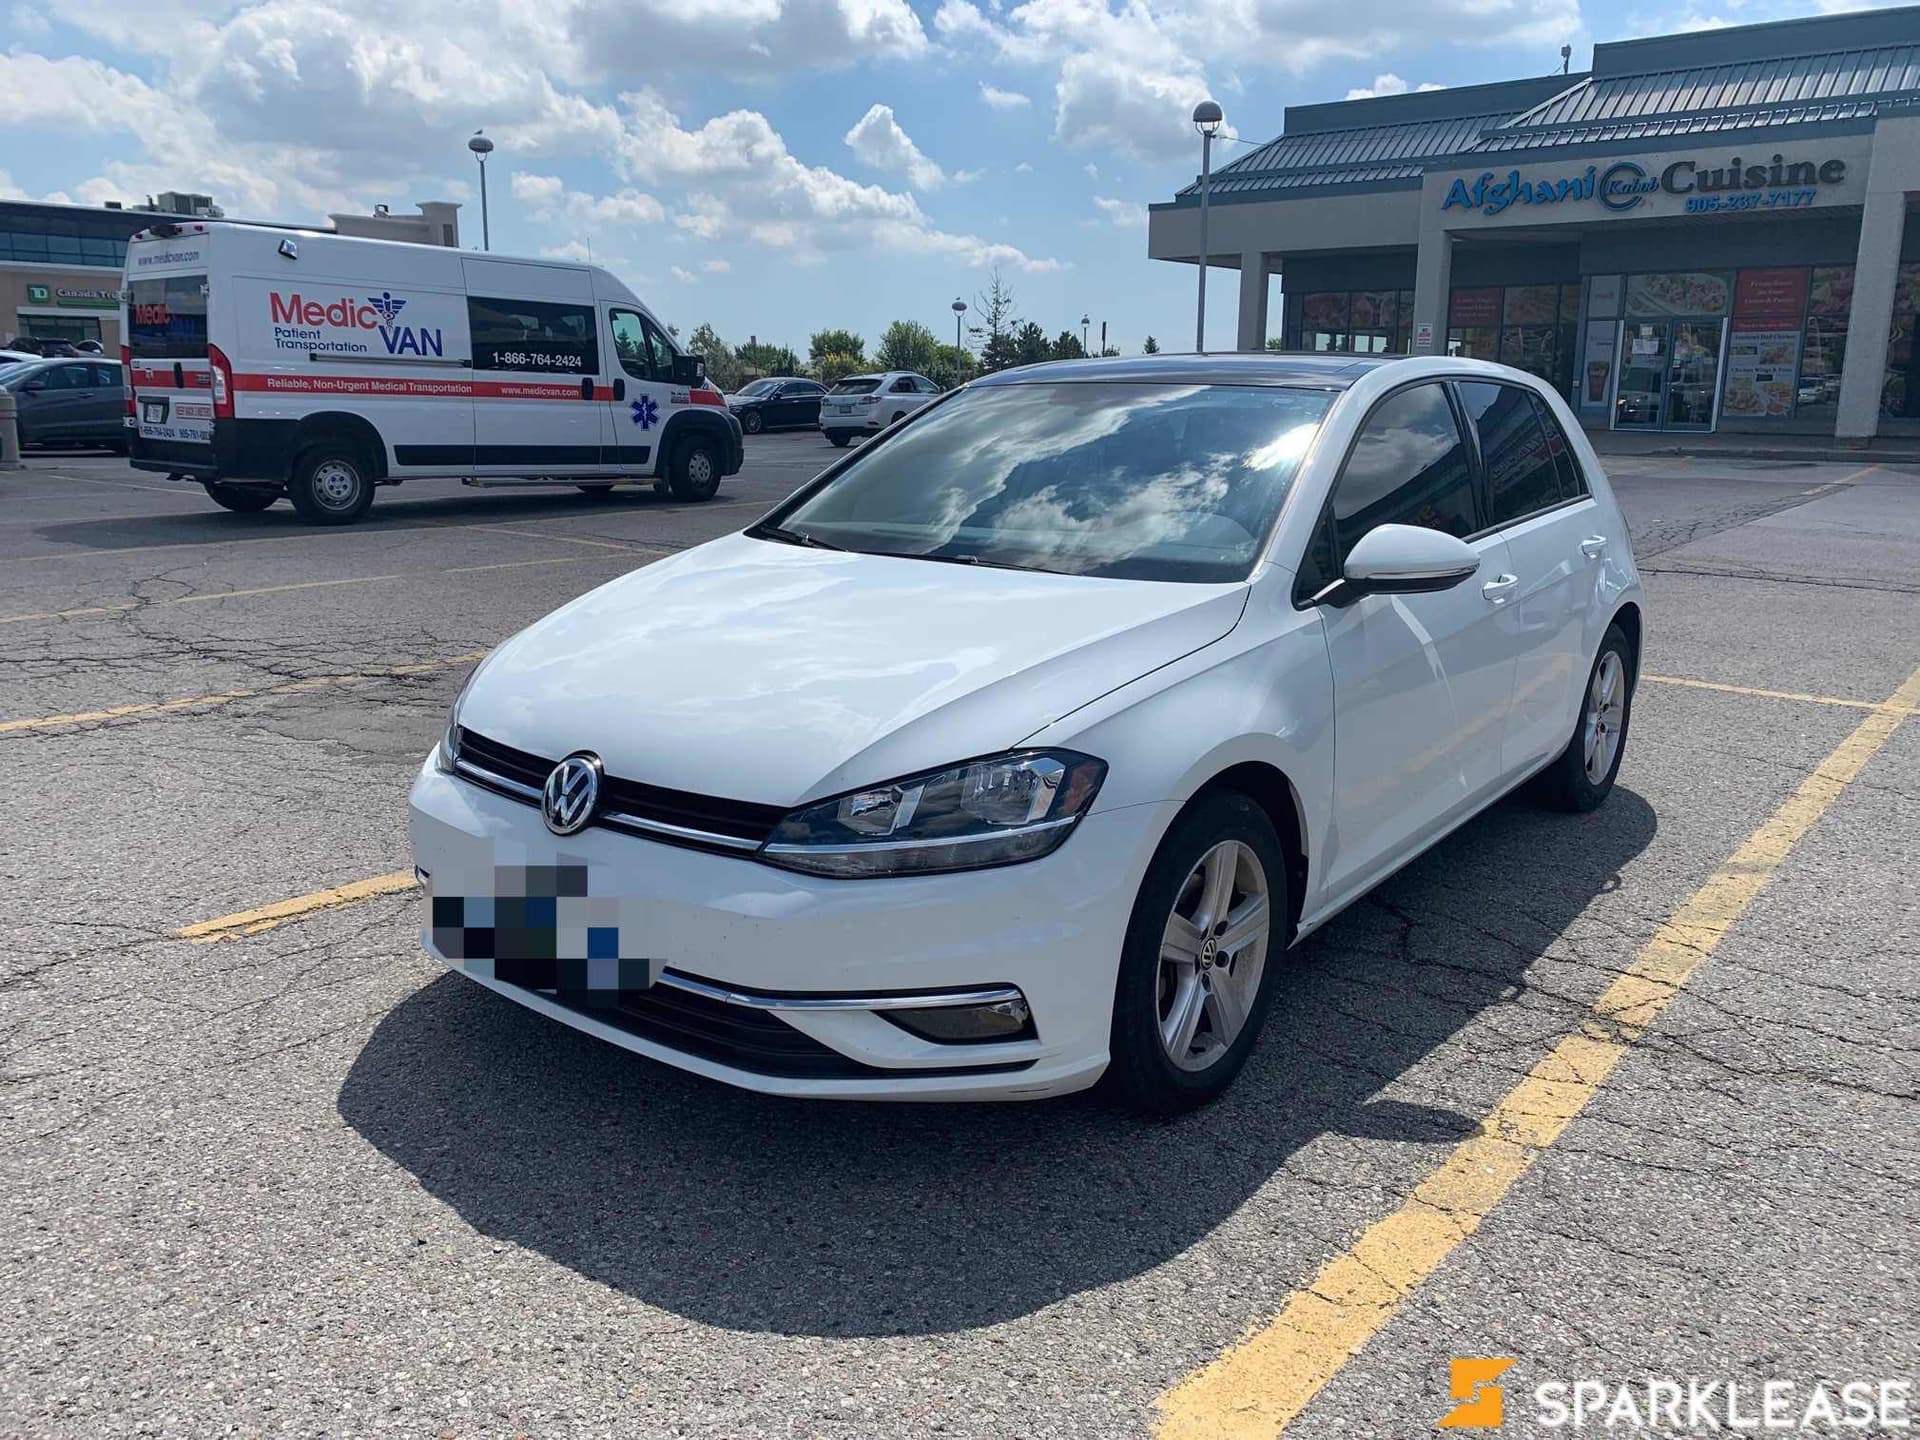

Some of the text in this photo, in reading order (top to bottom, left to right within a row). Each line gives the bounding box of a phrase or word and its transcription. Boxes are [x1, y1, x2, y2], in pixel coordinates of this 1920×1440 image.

[1441, 164, 1597, 216] Afghani
[1660, 153, 1847, 194] Cuisine
[29, 287, 48, 299] TD
[57, 289, 97, 298] Canada
[135, 302, 171, 325] Medic
[269, 292, 378, 330] Medic
[274, 327, 321, 340] Patient
[378, 325, 443, 357] VAN
[276, 338, 368, 353] Transportation
[492, 351, 582, 368] 1-866-764-2424
[267, 378, 472, 394] Reliable, Non-Urgent Medical Transportation
[501, 386, 580, 397] www.medicvan.com
